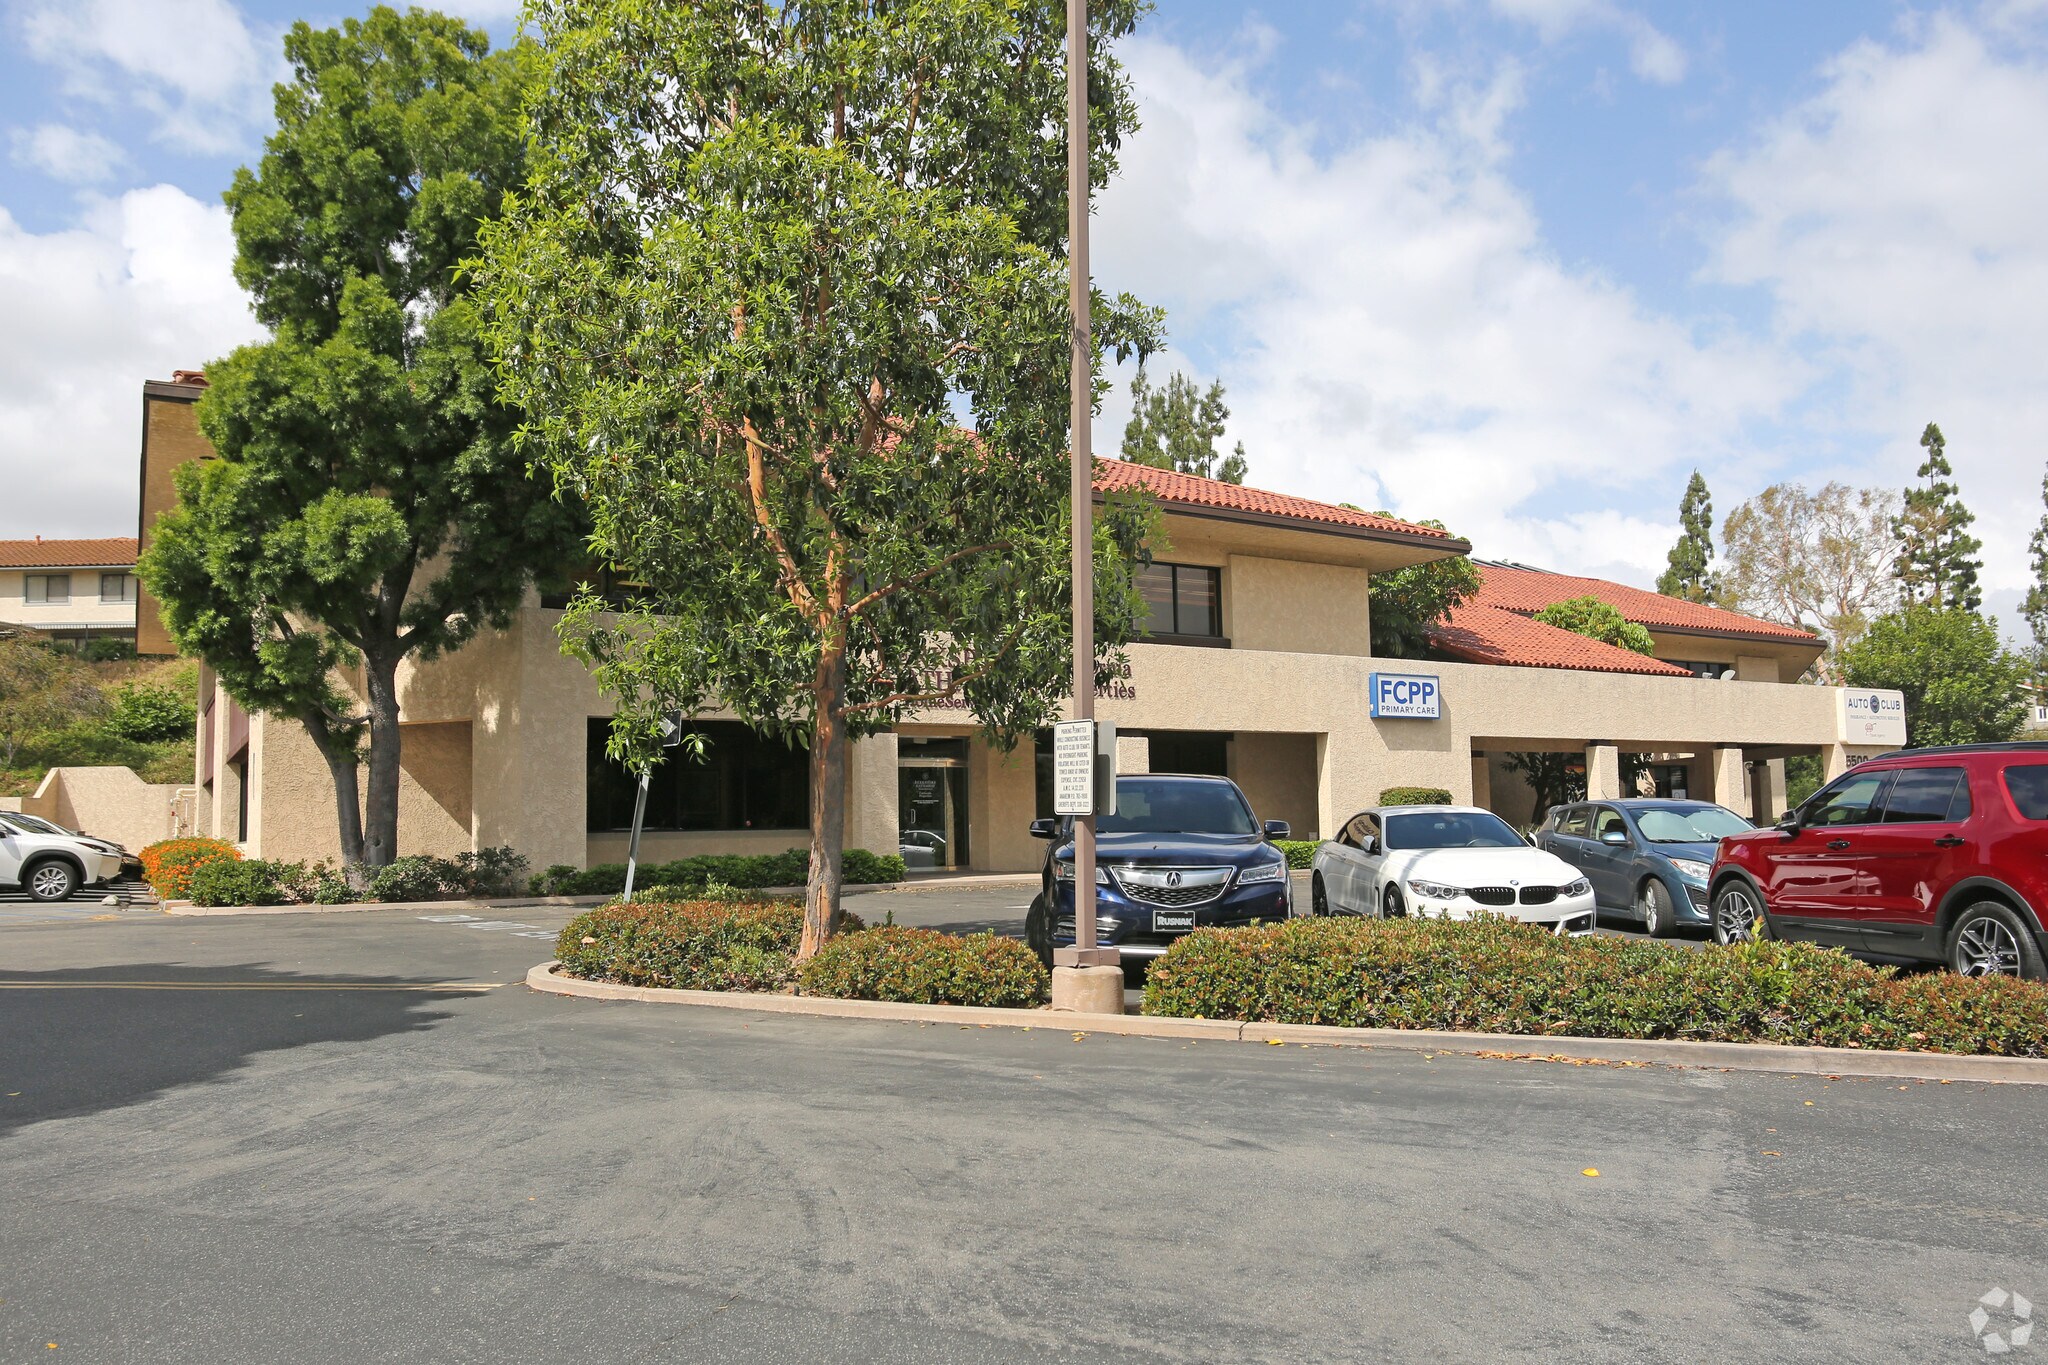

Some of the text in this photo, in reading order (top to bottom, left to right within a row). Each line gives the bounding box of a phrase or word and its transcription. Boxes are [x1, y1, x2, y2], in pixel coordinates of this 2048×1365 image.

[1381, 680, 1435, 704] FCPP
[1848, 698, 1901, 710] AUTO CLUB
[1381, 705, 1436, 715] PRIMARY CARE
[1157, 916, 1192, 926] RUSNAK
